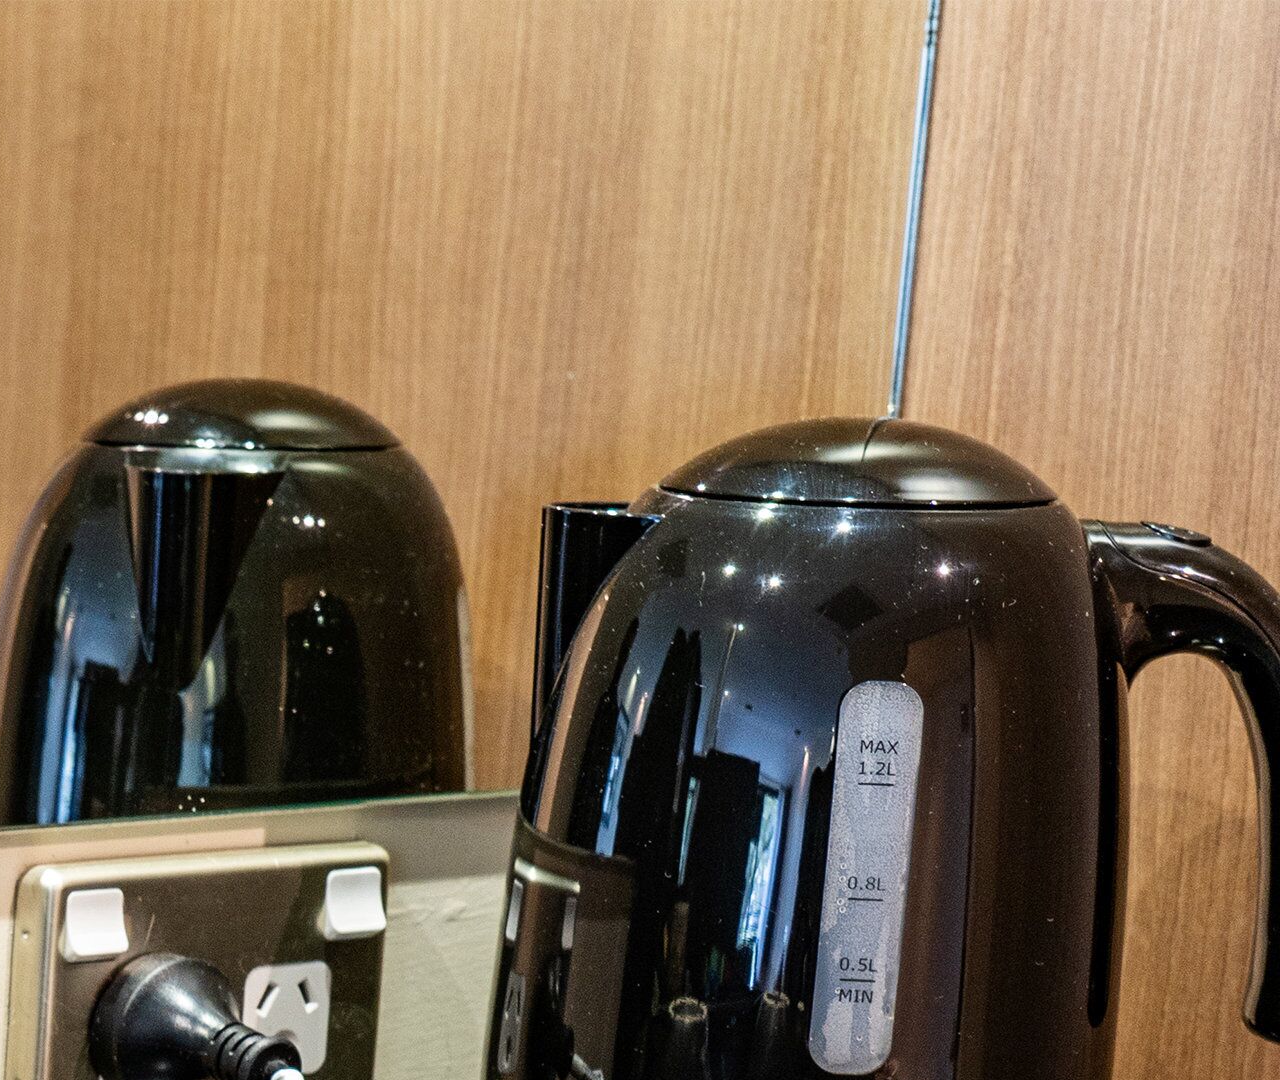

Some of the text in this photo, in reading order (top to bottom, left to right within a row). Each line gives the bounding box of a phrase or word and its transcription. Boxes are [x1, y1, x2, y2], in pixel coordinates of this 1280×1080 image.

[860, 739, 899, 755] MAX
[858, 761, 896, 776] 1.2L
[847, 875, 885, 891] 0.8L
[839, 957, 877, 973] 0.5L
[838, 988, 874, 1003] MIN
